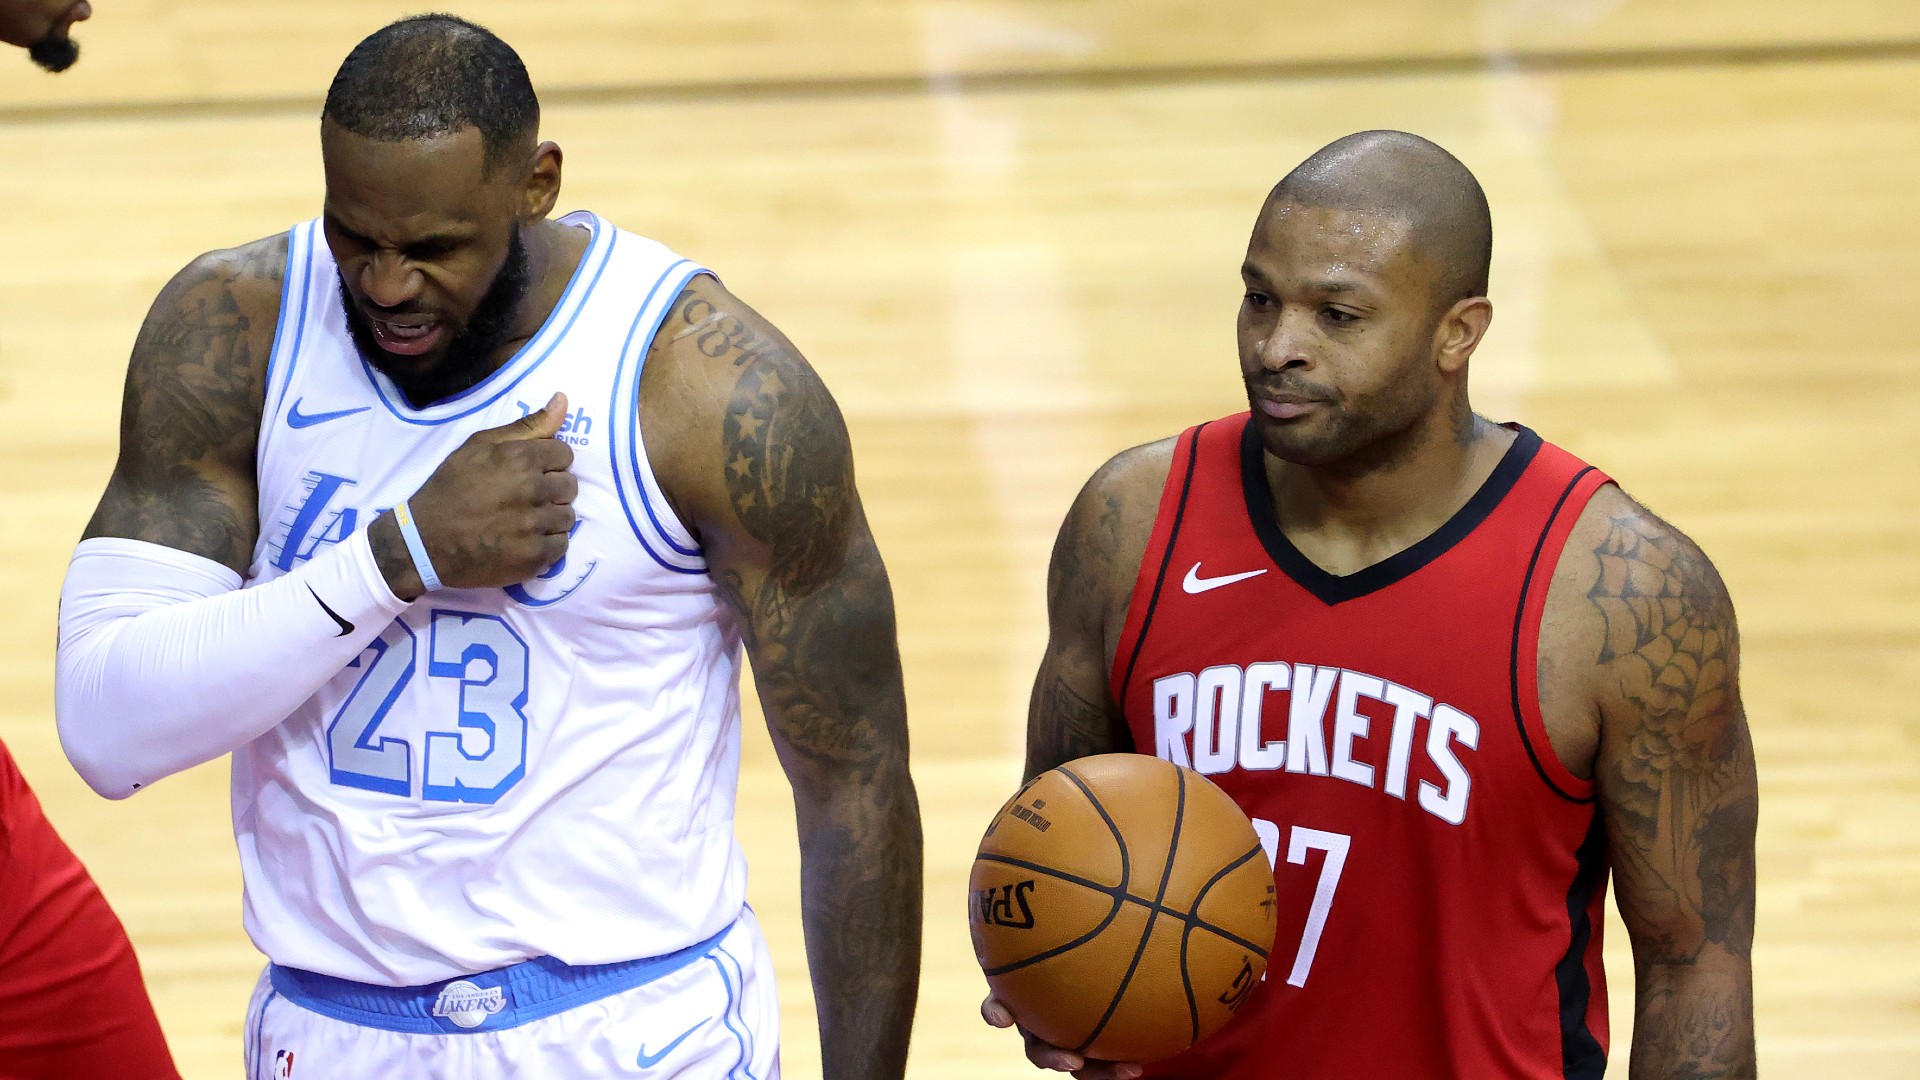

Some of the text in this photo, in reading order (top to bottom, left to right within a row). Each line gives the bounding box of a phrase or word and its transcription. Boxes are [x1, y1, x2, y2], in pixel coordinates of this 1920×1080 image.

[327, 609, 529, 804] 23
[1153, 661, 1480, 825] ROCKETS
[976, 880, 1034, 929] SPA
[439, 995, 499, 1014] LAKERS
